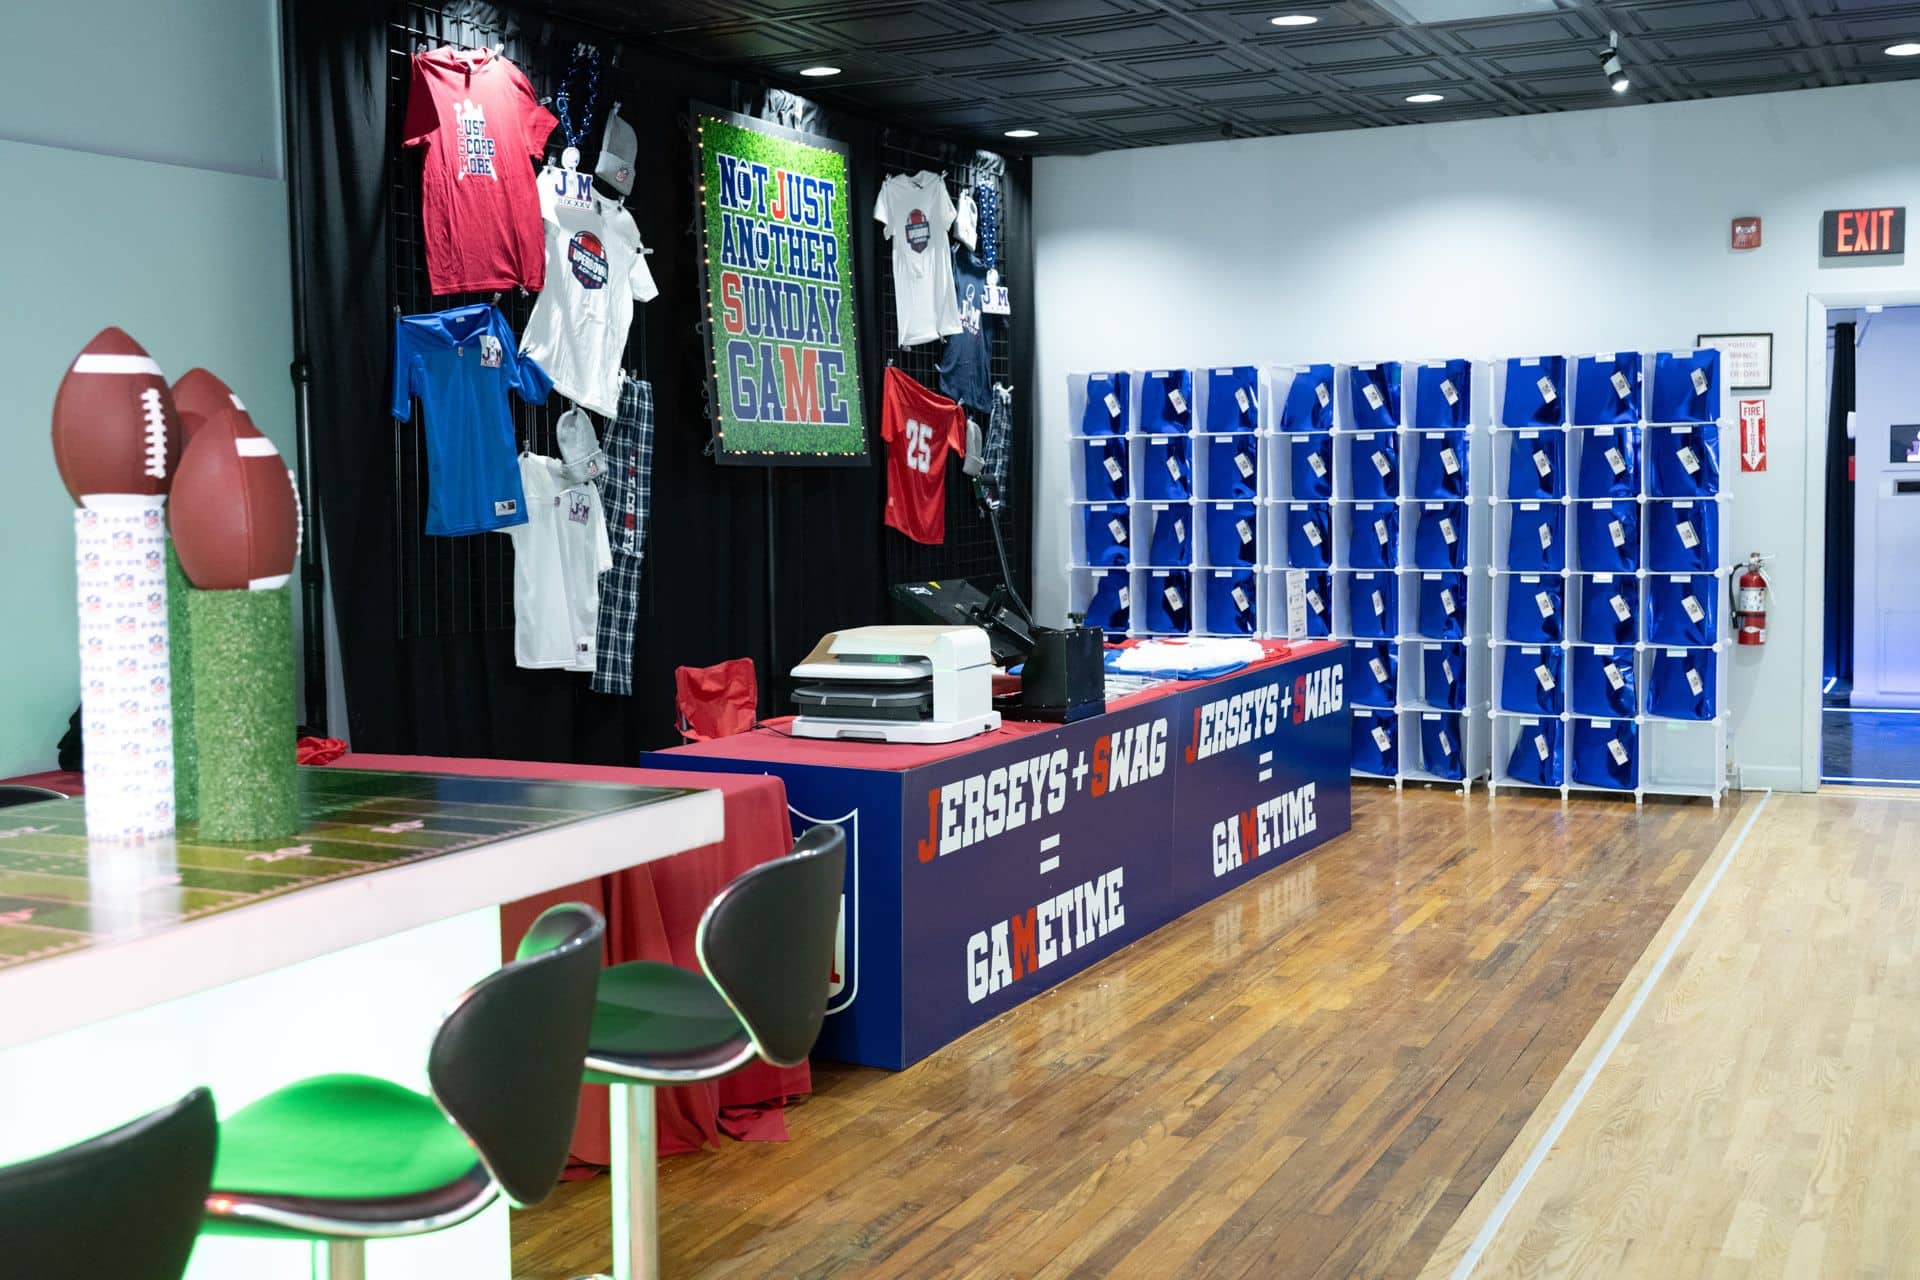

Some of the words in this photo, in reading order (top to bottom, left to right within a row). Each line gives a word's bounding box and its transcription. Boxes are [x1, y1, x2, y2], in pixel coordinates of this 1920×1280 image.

[458, 137, 495, 156] SCORE
[771, 169, 835, 230] JUST
[1837, 208, 1895, 252] EXIT
[720, 213, 839, 284] ANOTHER
[721, 271, 841, 345] SUNDAY
[726, 339, 849, 425] GAME
[1744, 406, 1761, 417] FIRE
[906, 418, 932, 474] 25
[1185, 682, 1279, 765] JERSEYS
[1280, 685, 1292, 718] +
[1292, 663, 1343, 725] SWAG
[917, 748, 1067, 864] JERSEYS
[1072, 750, 1089, 791] +
[1090, 717, 1167, 799] SWAG
[1212, 782, 1317, 878] GAMETIME
[967, 866, 1125, 1004] GAMETIME
